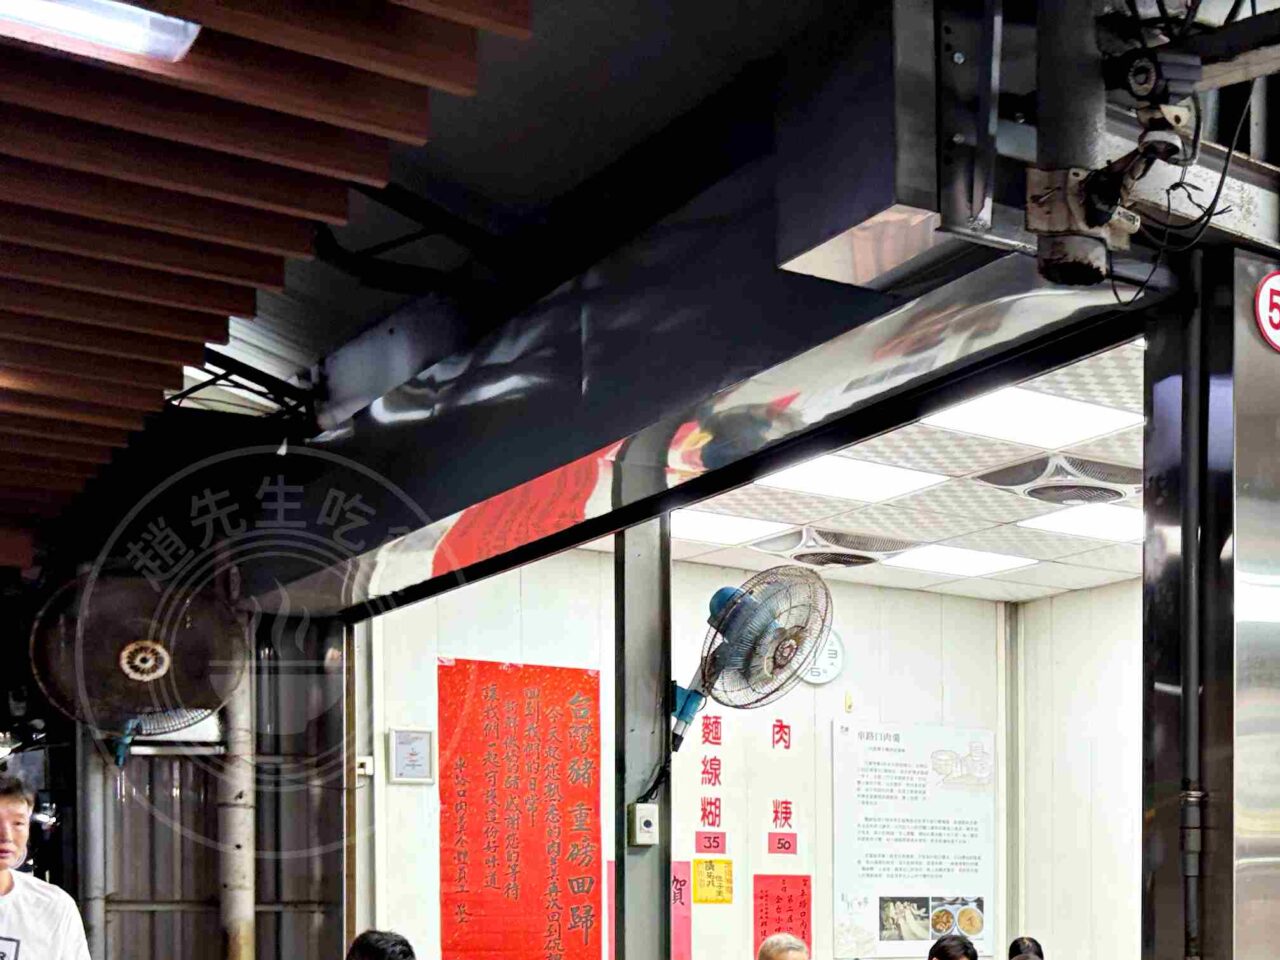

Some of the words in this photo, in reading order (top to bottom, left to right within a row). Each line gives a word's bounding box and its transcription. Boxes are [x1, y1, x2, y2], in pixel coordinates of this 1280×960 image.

[701, 714, 723, 828] 麵線糊
[703, 836, 720, 849] 35
[776, 838, 791, 850] 50
[672, 876, 687, 906] 賀
